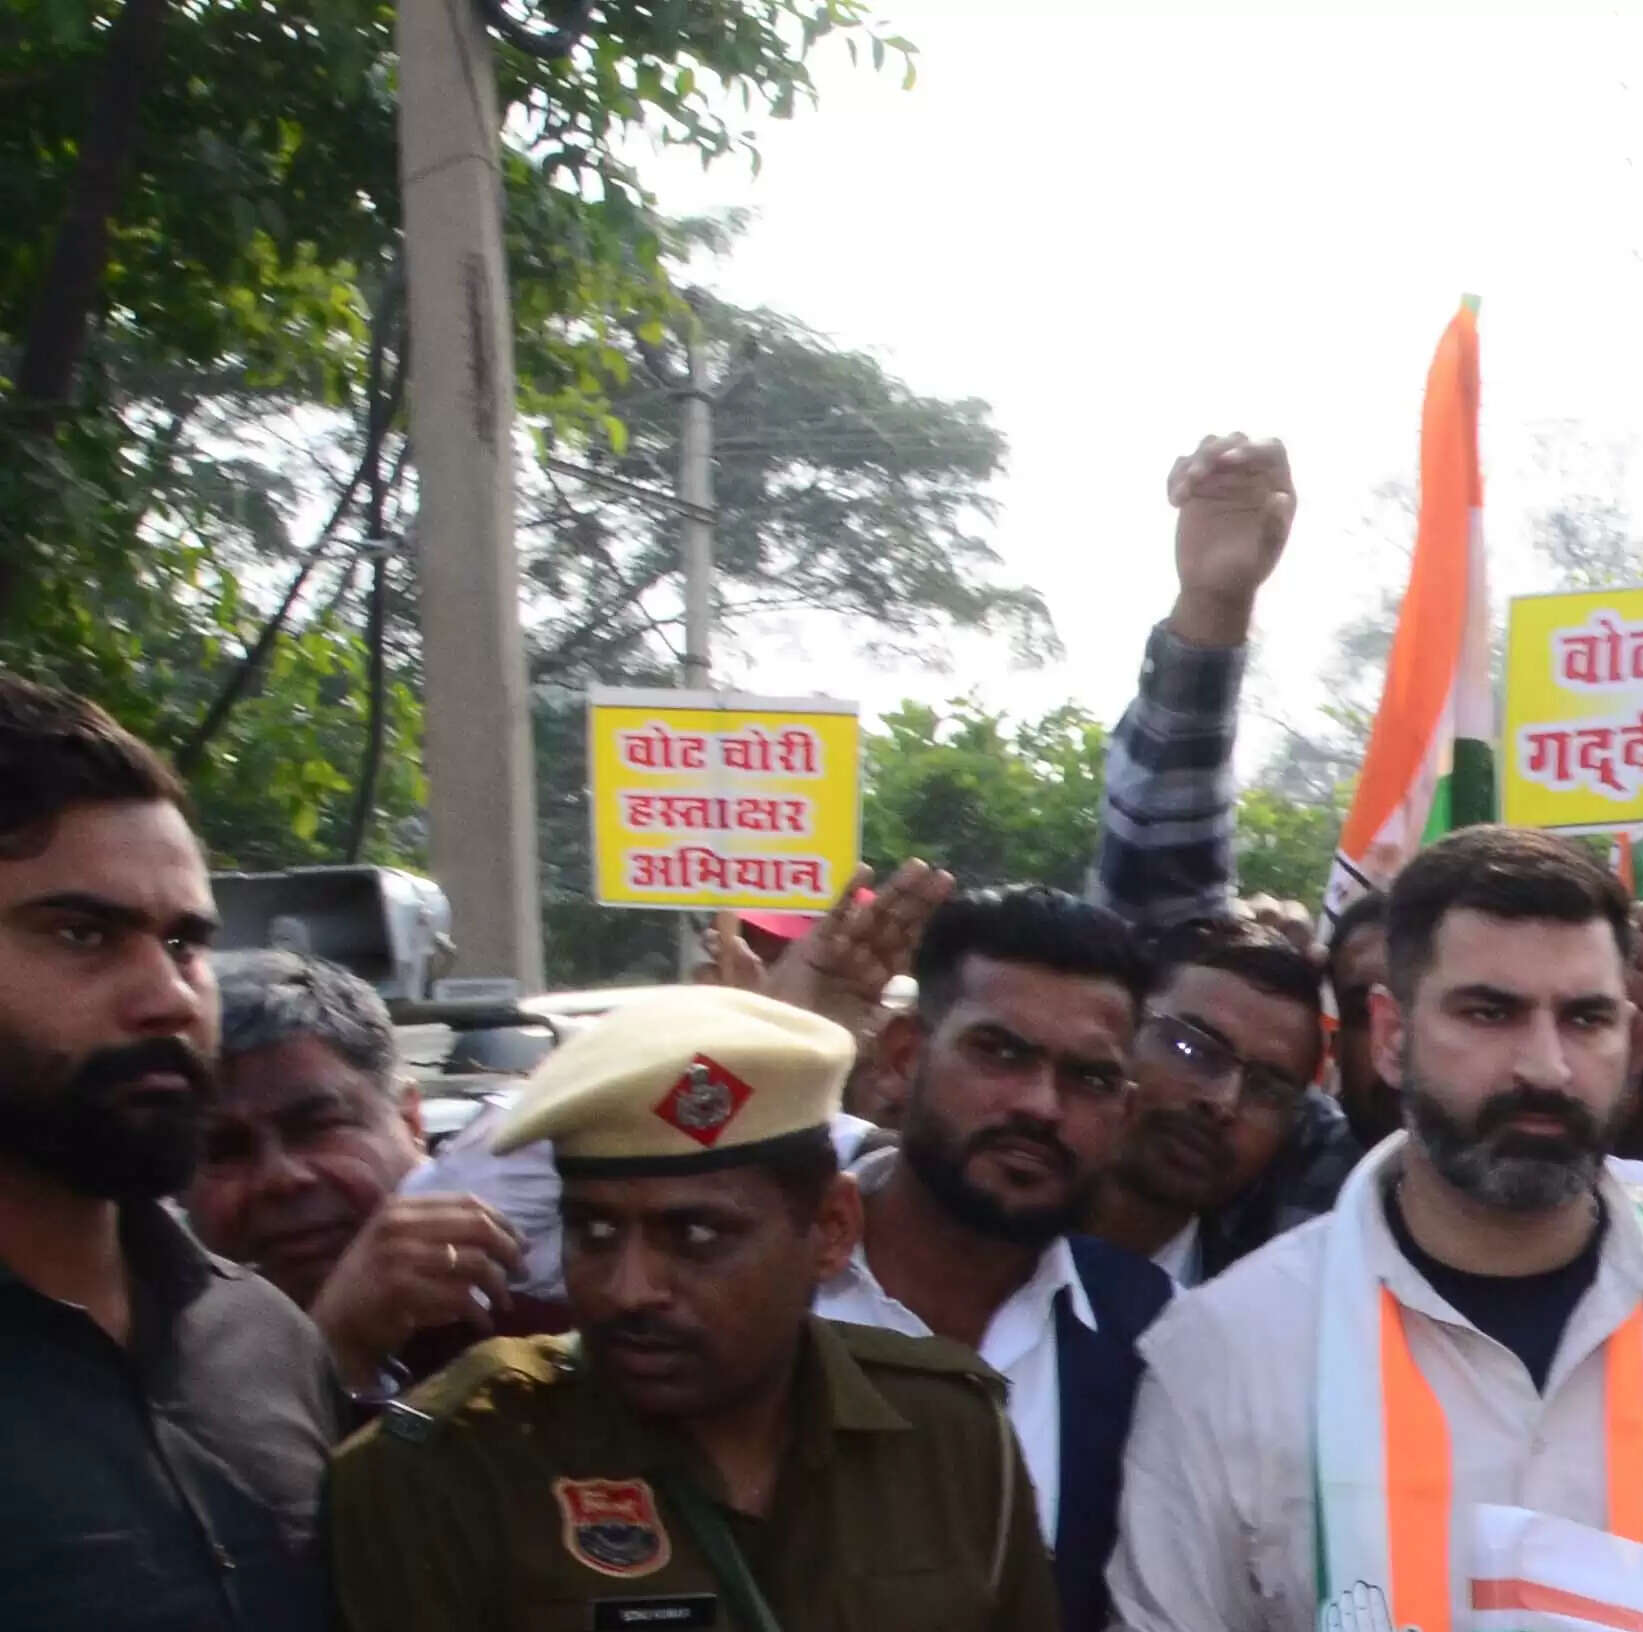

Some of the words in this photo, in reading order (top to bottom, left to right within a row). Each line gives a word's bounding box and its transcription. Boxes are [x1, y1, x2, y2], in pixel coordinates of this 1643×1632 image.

[624, 728, 706, 769] वोट
[721, 731, 817, 773] चोरी
[626, 794, 808, 832] हस्ताक्षर
[632, 847, 823, 893] अभियान
